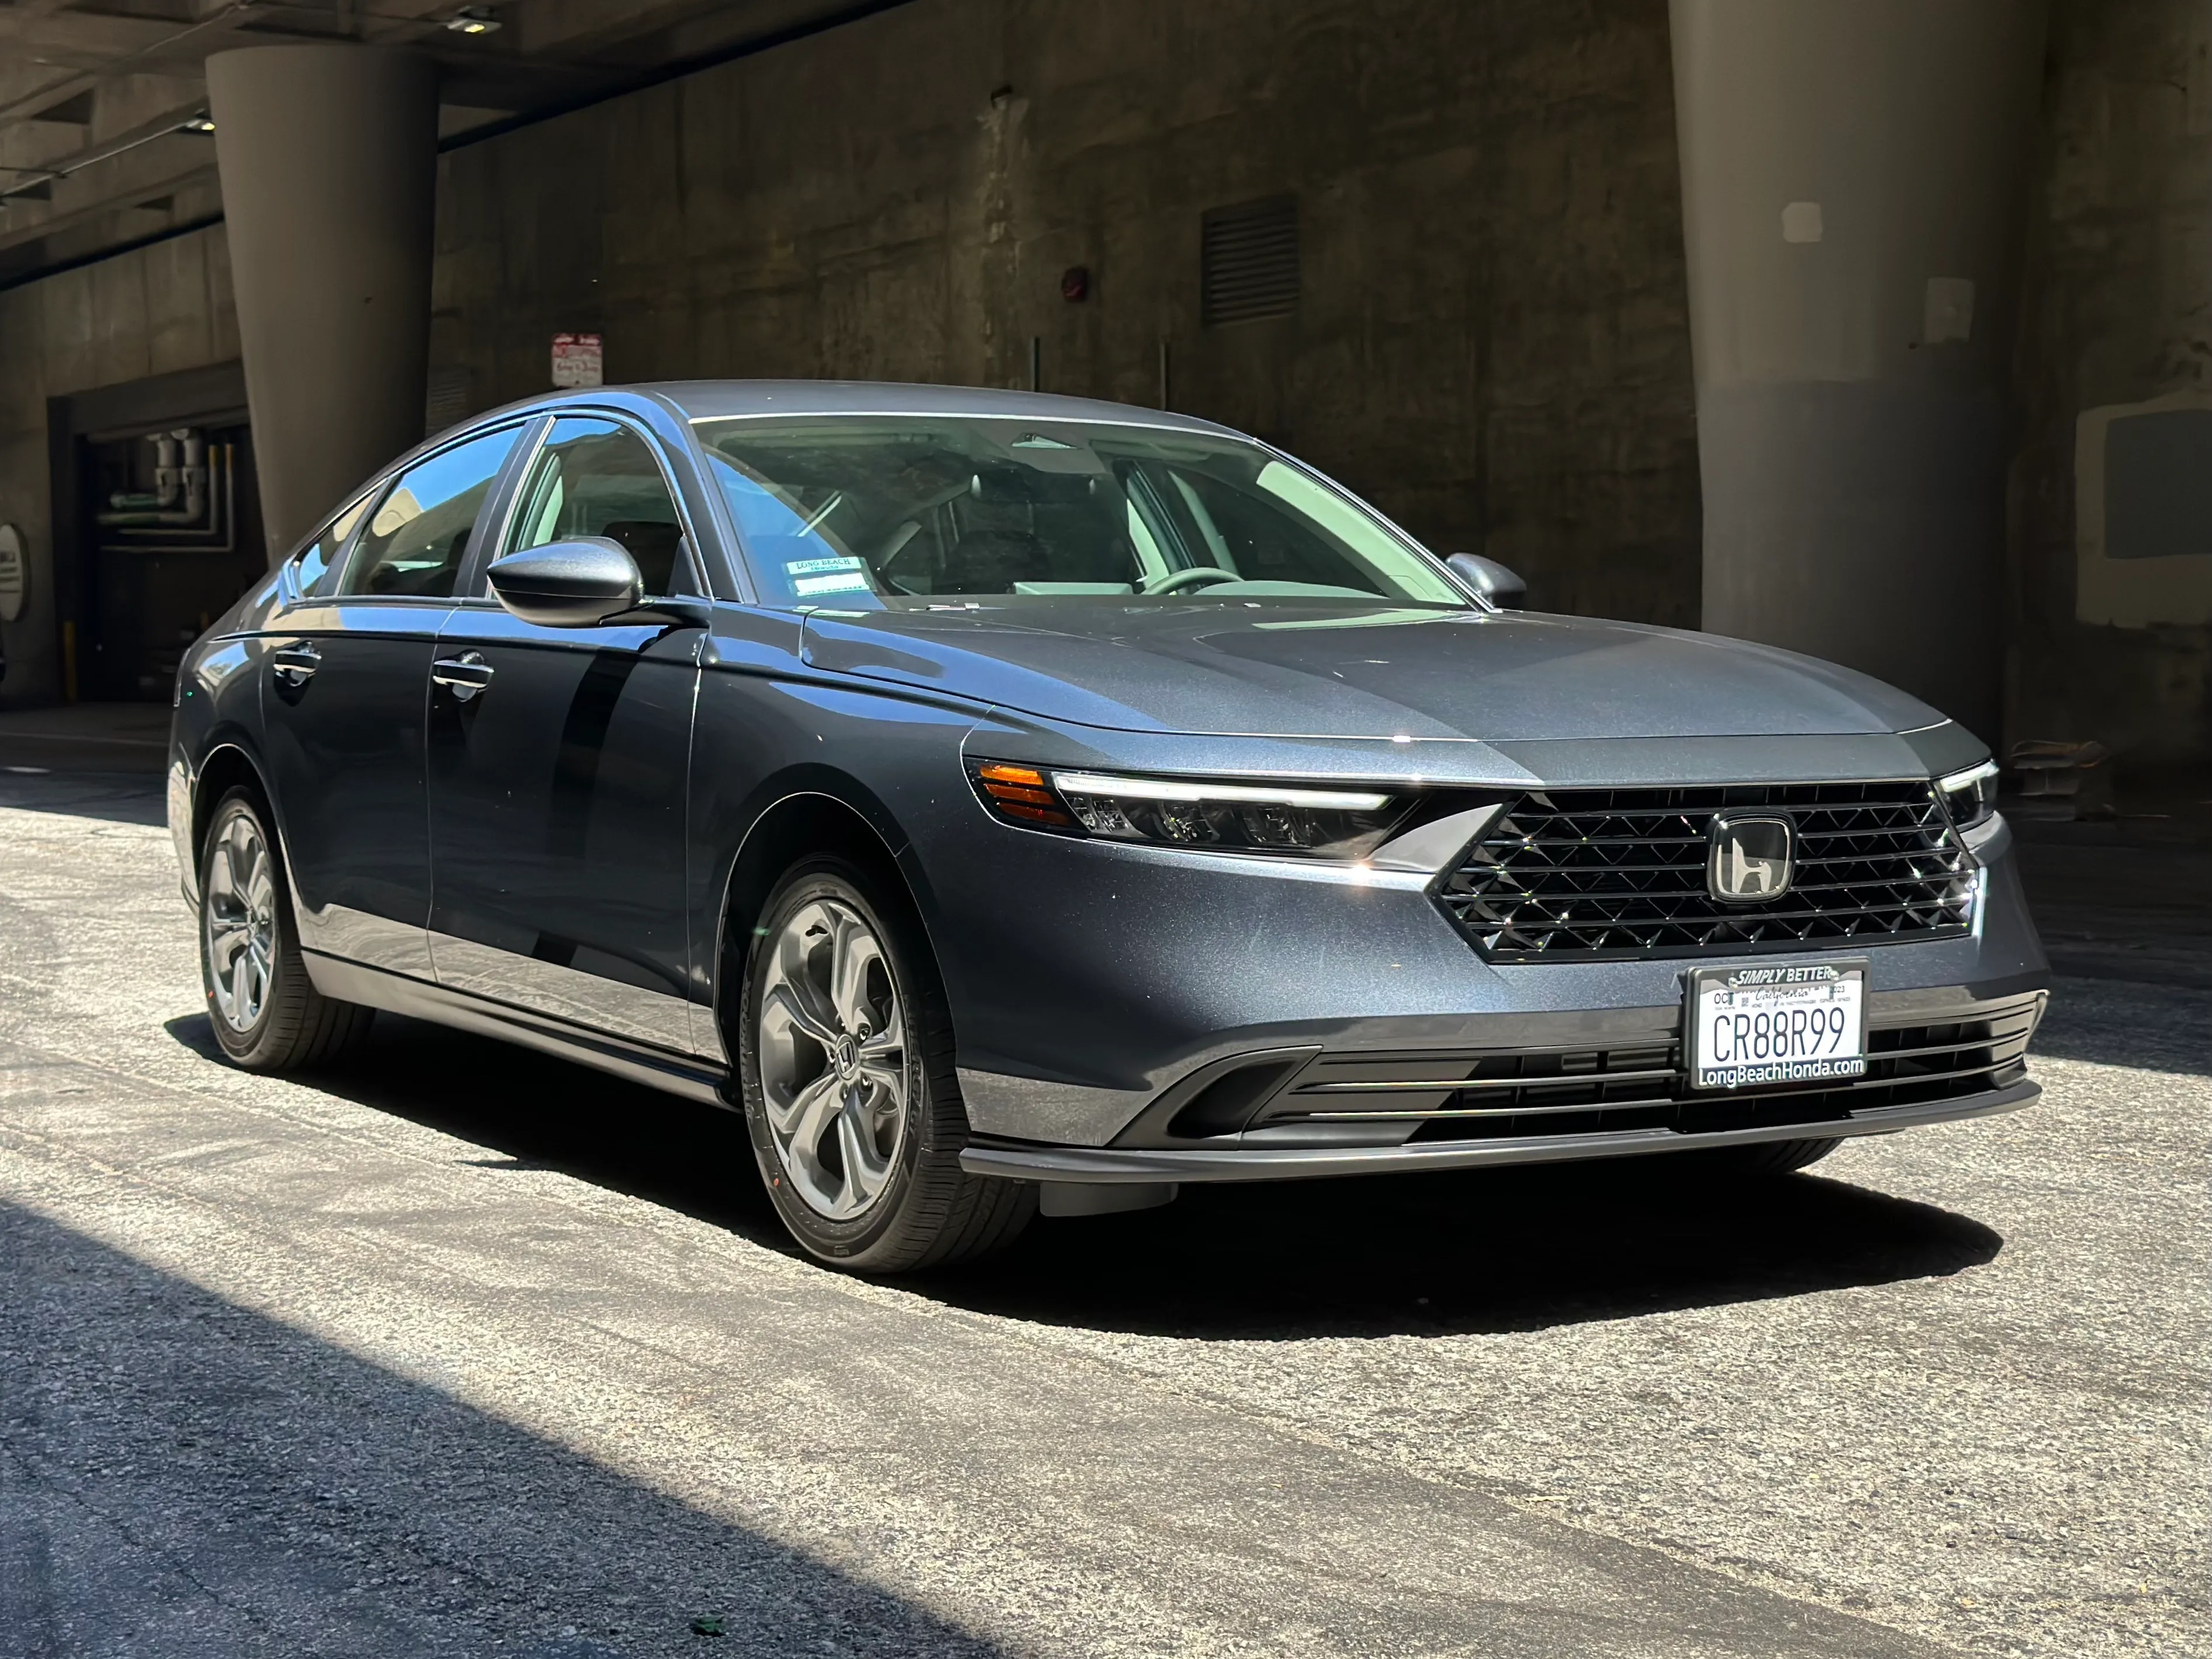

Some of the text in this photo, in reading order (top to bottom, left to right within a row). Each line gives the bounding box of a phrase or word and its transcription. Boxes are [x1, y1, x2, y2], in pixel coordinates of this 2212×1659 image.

[796, 561, 819, 570] LONG
[1737, 966, 1832, 985] SIMPLY BETTER
[1714, 1006, 1846, 1062] CR88R99
[1698, 1058, 1864, 1089] LongBeachHonda.com
